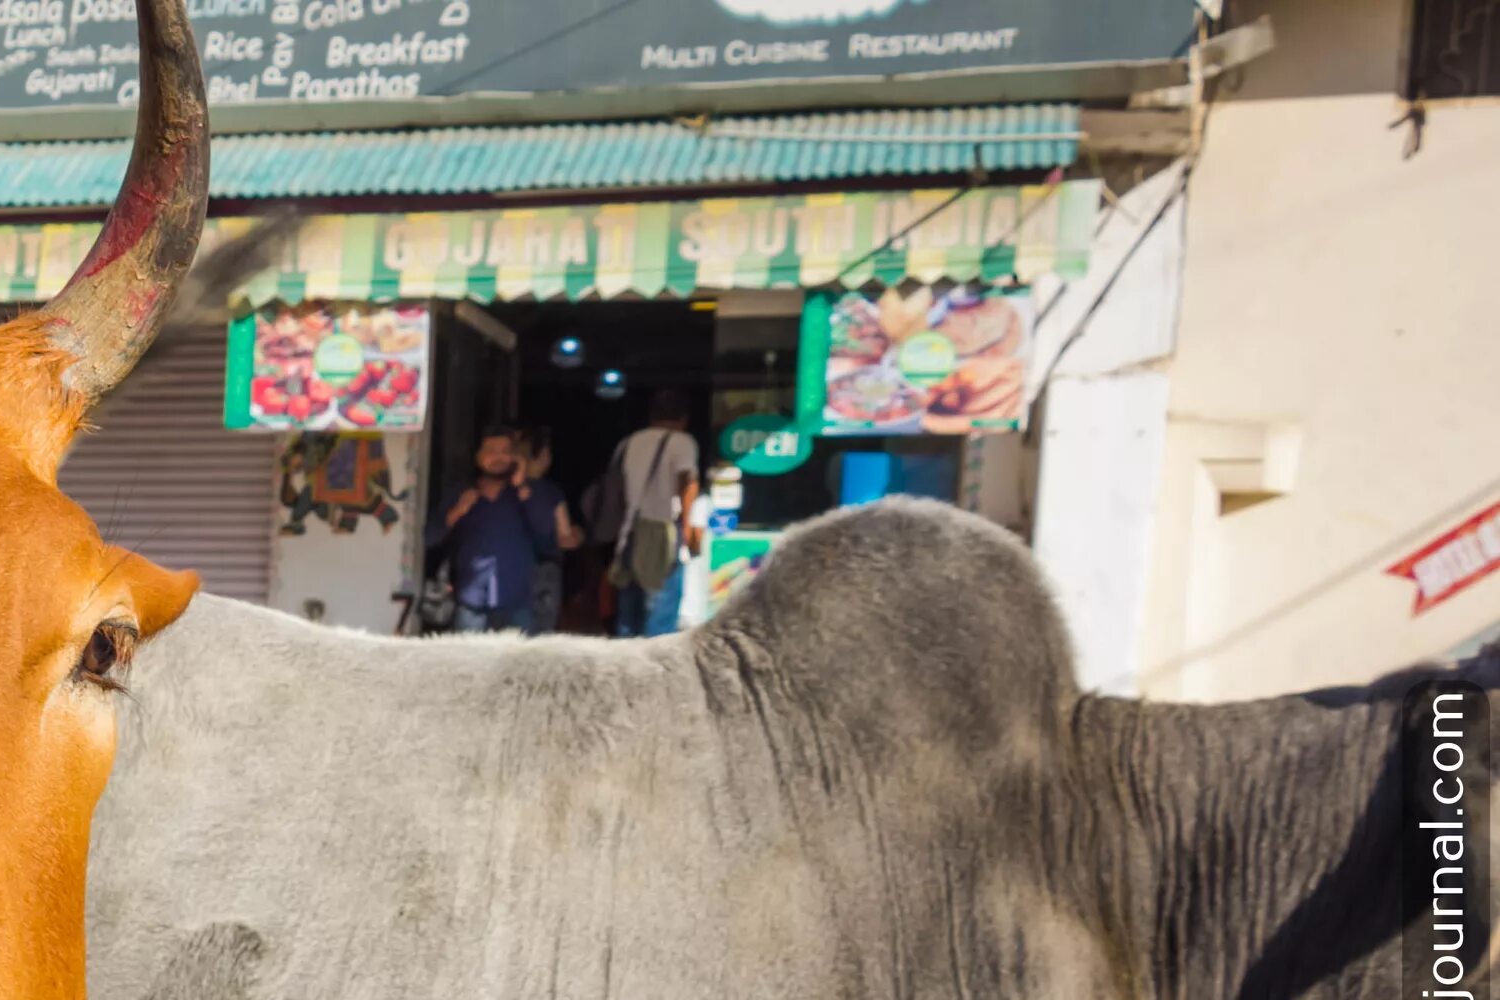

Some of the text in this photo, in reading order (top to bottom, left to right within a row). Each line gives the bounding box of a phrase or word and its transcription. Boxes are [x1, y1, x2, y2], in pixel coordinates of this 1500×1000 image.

[303, 0, 365, 31] Cold
[4, 26, 67, 49] Lunch
[203, 30, 264, 61] Rice
[326, 31, 470, 69] Breakfast
[25, 66, 116, 100] Gujarati
[290, 66, 421, 102] Parathas
[383, 213, 637, 272] GUJARATI
[678, 203, 856, 261] SOUTH
